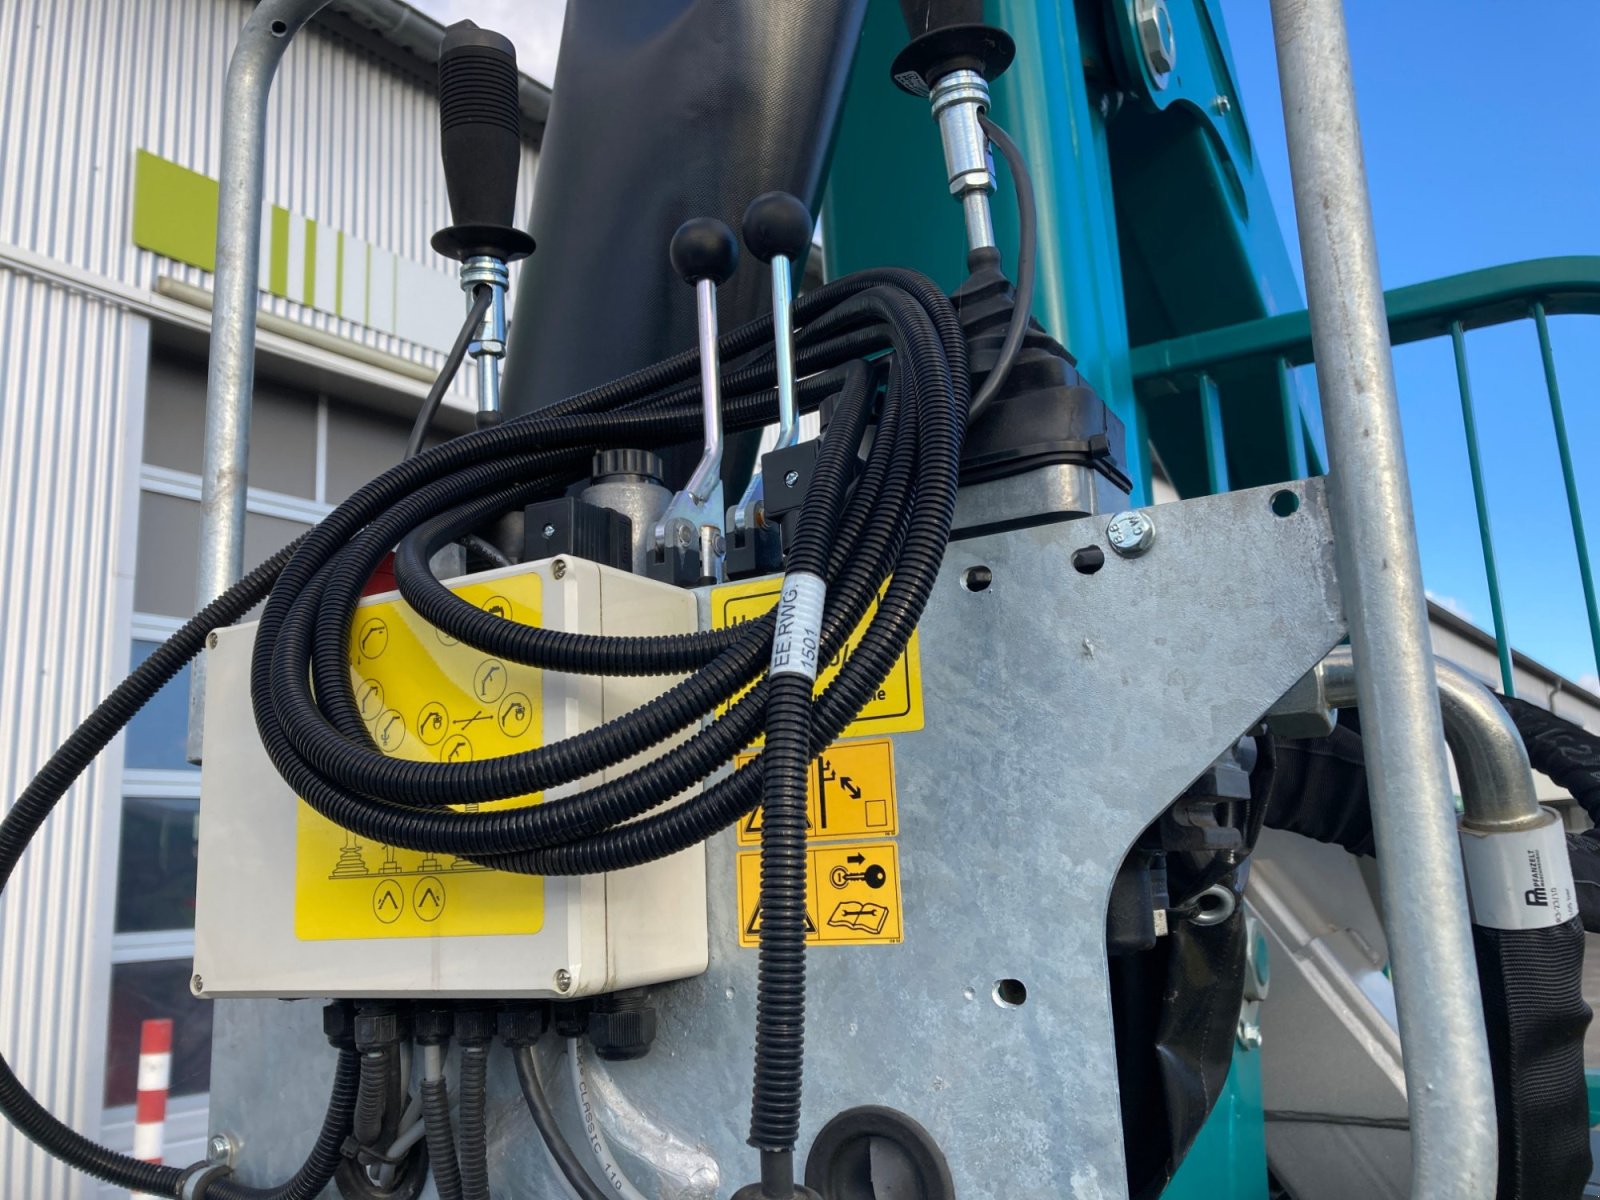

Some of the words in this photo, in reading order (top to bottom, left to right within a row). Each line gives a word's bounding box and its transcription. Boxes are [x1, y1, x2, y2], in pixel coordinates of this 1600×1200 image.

[800, 628, 818, 669] 1501
[1527, 850, 1540, 887] PFANZELT
[579, 1082, 602, 1154] CLASSIC
[603, 1163, 622, 1191] 110
